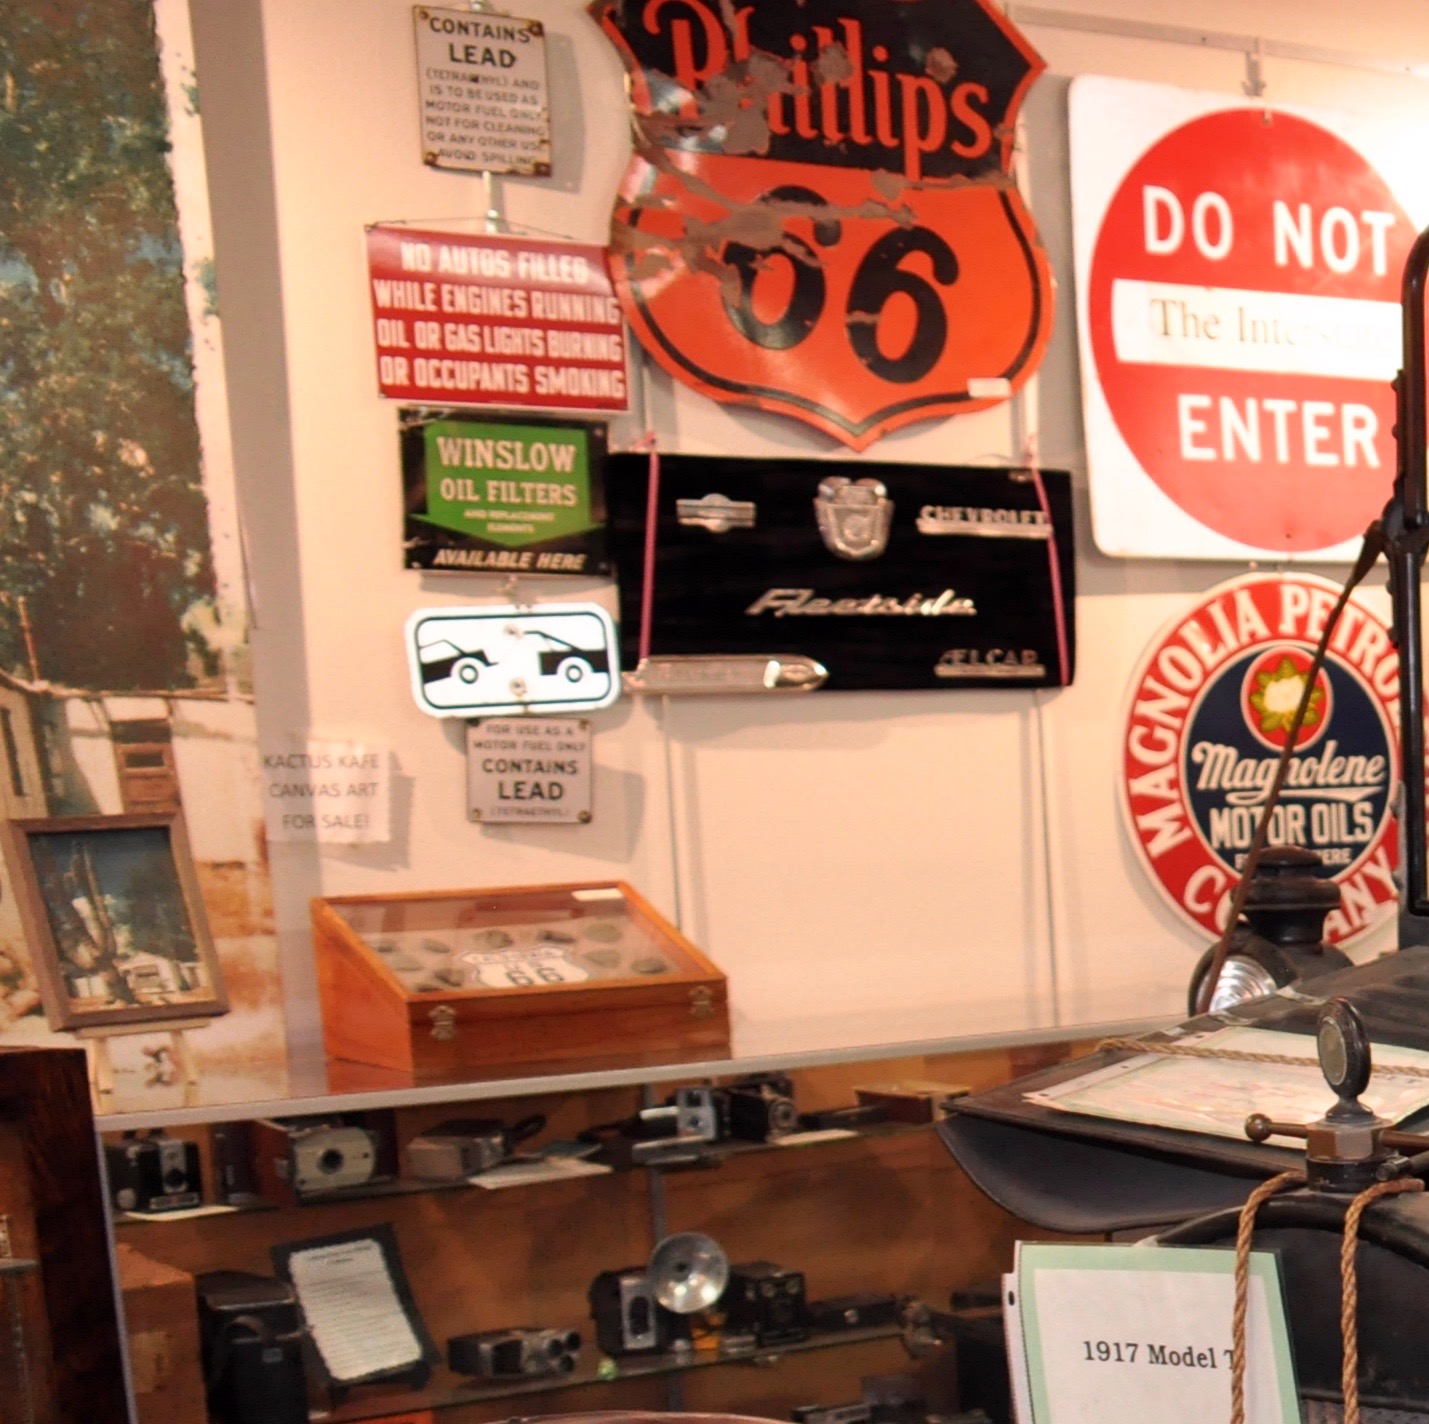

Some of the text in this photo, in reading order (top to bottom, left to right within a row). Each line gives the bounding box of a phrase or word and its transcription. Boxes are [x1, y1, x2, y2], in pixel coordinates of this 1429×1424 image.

[430, 17, 530, 43] CONTAINS
[448, 43, 516, 68] LEAD
[426, 101, 470, 113] MOTOR
[475, 104, 506, 118] FUEL
[447, 86, 463, 97] TO
[466, 88, 482, 99] BE
[485, 90, 517, 103] USED
[521, 93, 538, 105] AS
[426, 116, 449, 126] NOT
[454, 118, 479, 129] FOR
[426, 131, 445, 142] OR
[449, 133, 474, 144] ANY
[478, 135, 517, 148] OTHER
[1142, 183, 1397, 278] DO NOT
[401, 241, 589, 283] NO AUTOS FILLED
[721, 185, 960, 384] 66
[373, 279, 621, 324] WHILE ENGINES RUNNING
[1148, 296, 1221, 342] The
[376, 318, 622, 362] OIL OR GAS LIGHTS BURNING
[379, 355, 626, 399] OR OCCUPANTS SMOKING
[1177, 394, 1380, 470] ENTER
[436, 436, 577, 473] WINSLOW
[439, 477, 578, 507] OIL FILTERS
[433, 549, 588, 570] AVAILABLE HERE
[1127, 589, 1273, 859] MAGNOLIA
[263, 753, 379, 769] KACTUS KAFE
[482, 758, 577, 775] CONTAINS
[269, 782, 378, 798] CANVAS ART
[498, 780, 564, 801] LEAD
[282, 814, 315, 829] FOR
[1209, 802, 1373, 850] MOTOR OILS
[1083, 1340, 1139, 1363] 1917
[1147, 1344, 1218, 1369] Model
